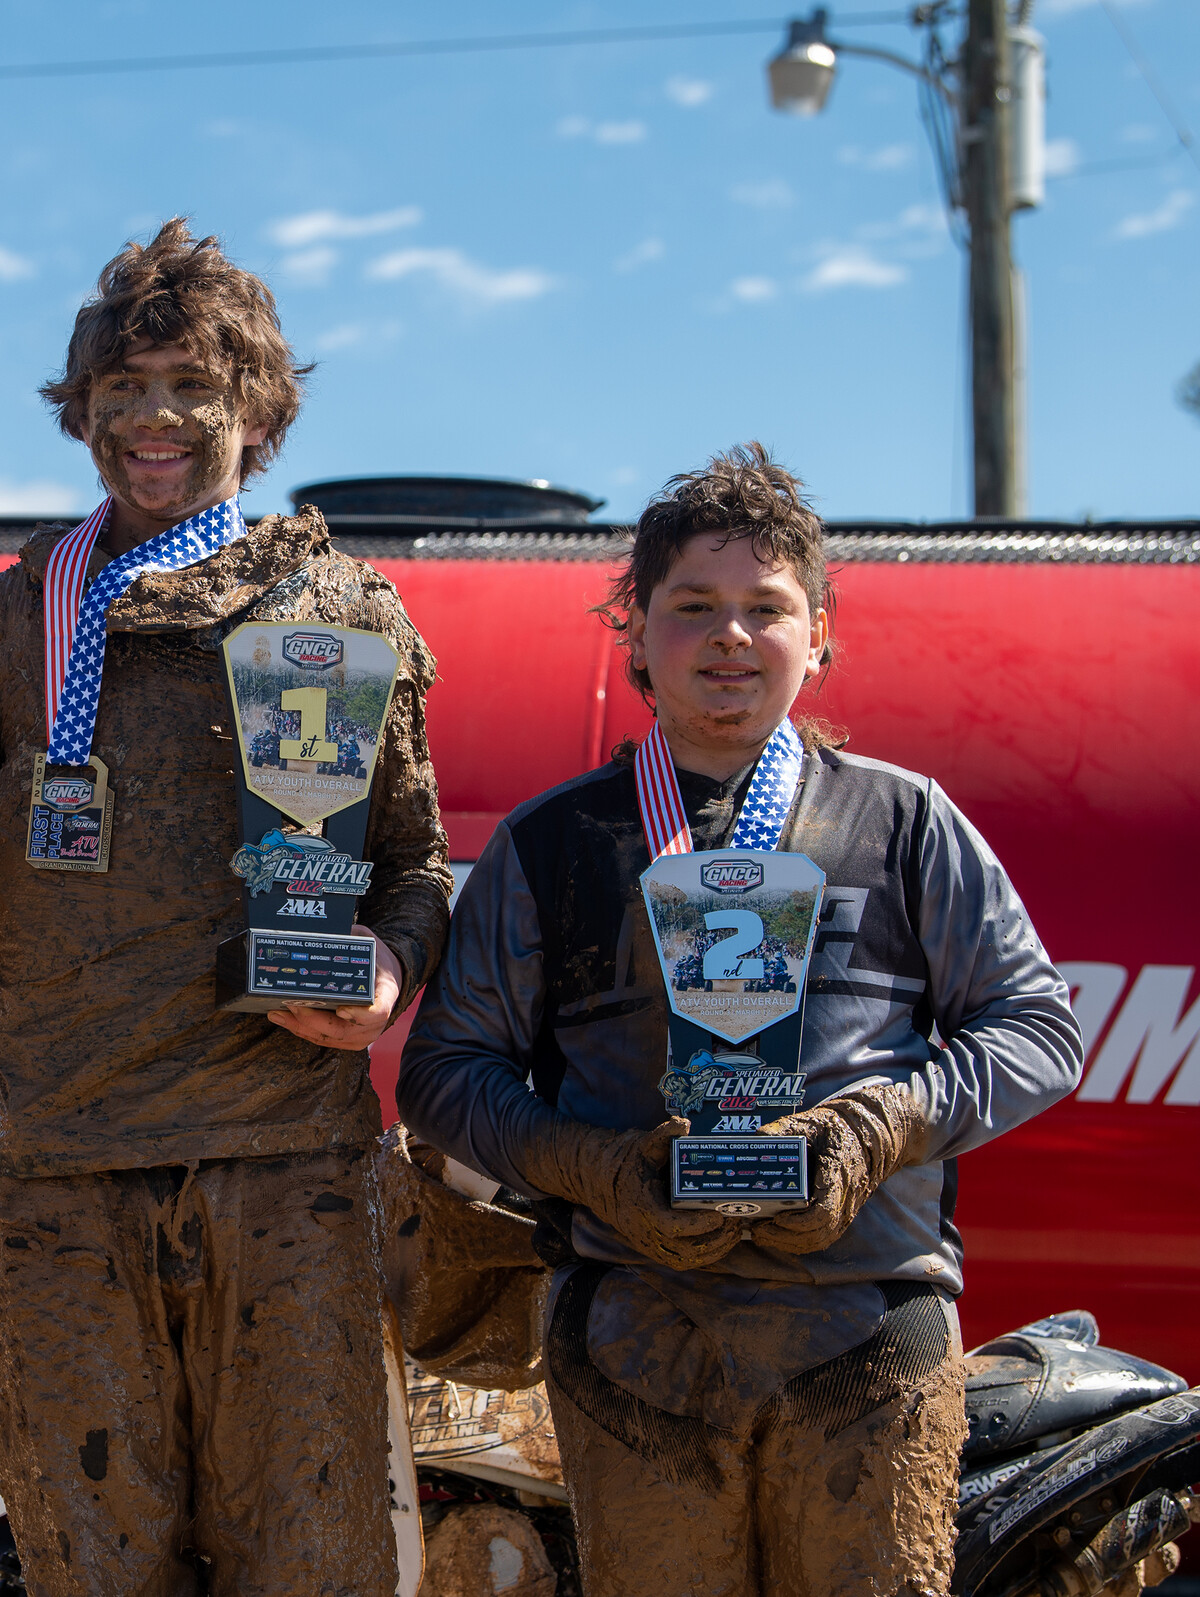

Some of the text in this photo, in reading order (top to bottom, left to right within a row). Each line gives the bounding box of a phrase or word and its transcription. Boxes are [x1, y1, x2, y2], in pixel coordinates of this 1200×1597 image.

[288, 641, 338, 656] GNCC
[280, 687, 338, 762] 1
[300, 735, 322, 758] st
[47, 786, 90, 798] GNCC
[254, 776, 360, 791] ATV YOUTH OVERALL
[104, 800, 113, 832] COUNTRY
[31, 806, 49, 858] FIRST
[48, 814, 63, 858] PLACE
[71, 836, 99, 849] ATV
[304, 854, 347, 862] SPECIALIZED
[274, 859, 368, 884] GENERAL
[706, 867, 759, 881] GNCC
[289, 880, 322, 892] 2022
[276, 899, 327, 918] AMA
[704, 910, 764, 979] 2
[723, 960, 743, 977] nd
[704, 998, 739, 1006] YOUTH
[706, 1076, 802, 1096] GENERAL
[721, 1097, 756, 1108] 2022
[711, 1116, 761, 1132] AMA
[990, 1462, 1096, 1544] POWERSPORTS
